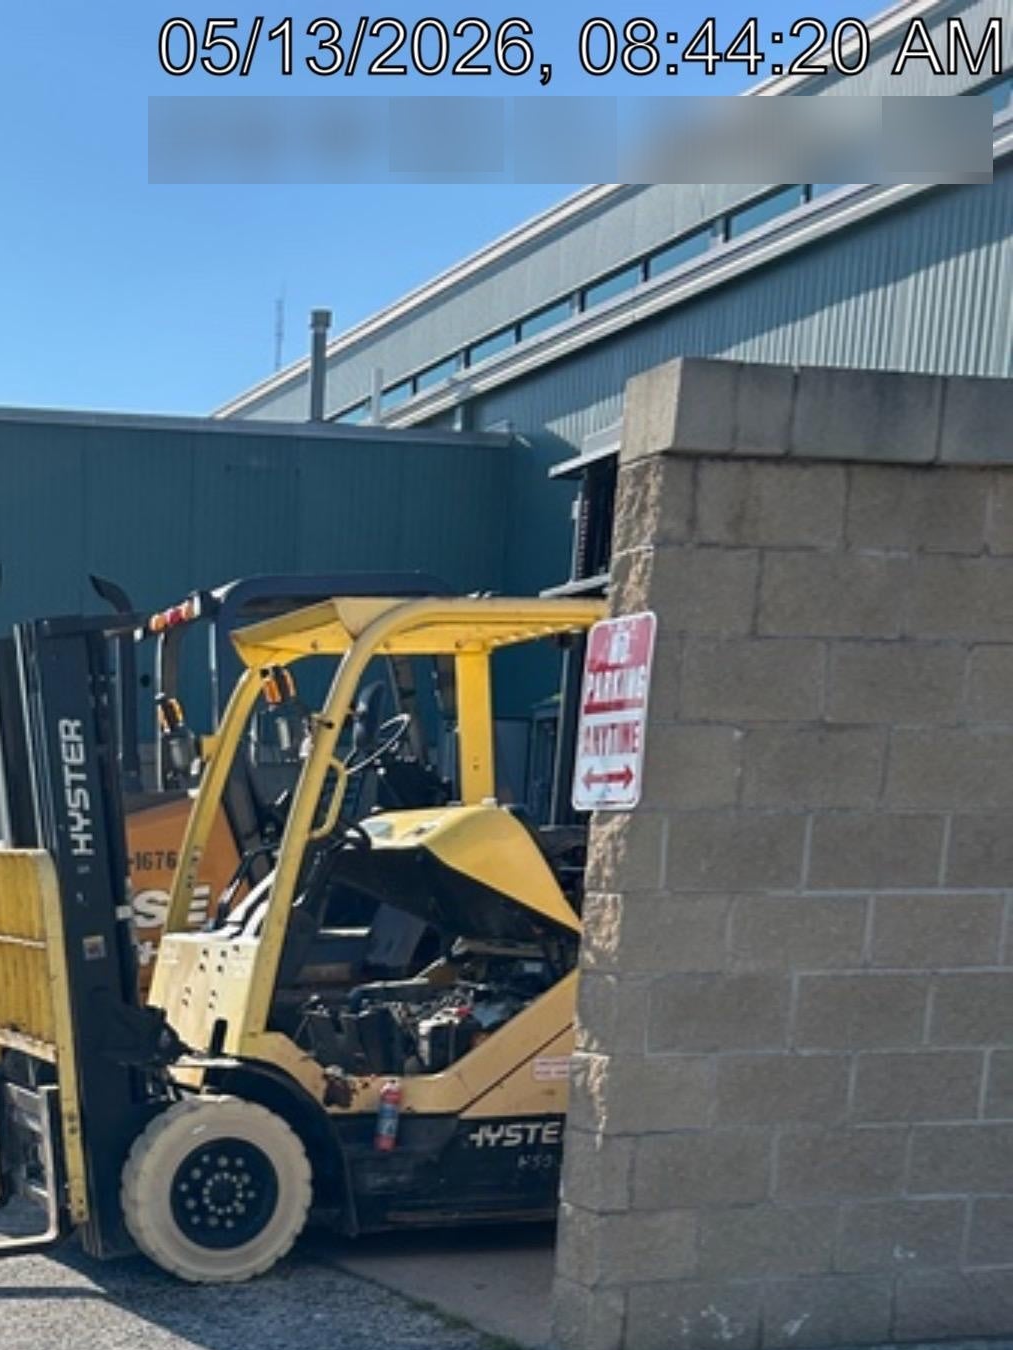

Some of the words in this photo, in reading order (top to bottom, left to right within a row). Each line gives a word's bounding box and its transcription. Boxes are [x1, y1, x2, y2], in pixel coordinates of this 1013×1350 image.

[584, 721, 640, 757] ANYTIME
[59, 718, 95, 856] HYSTER
[133, 885, 210, 928] SE
[469, 1121, 562, 1148] HYSTE
